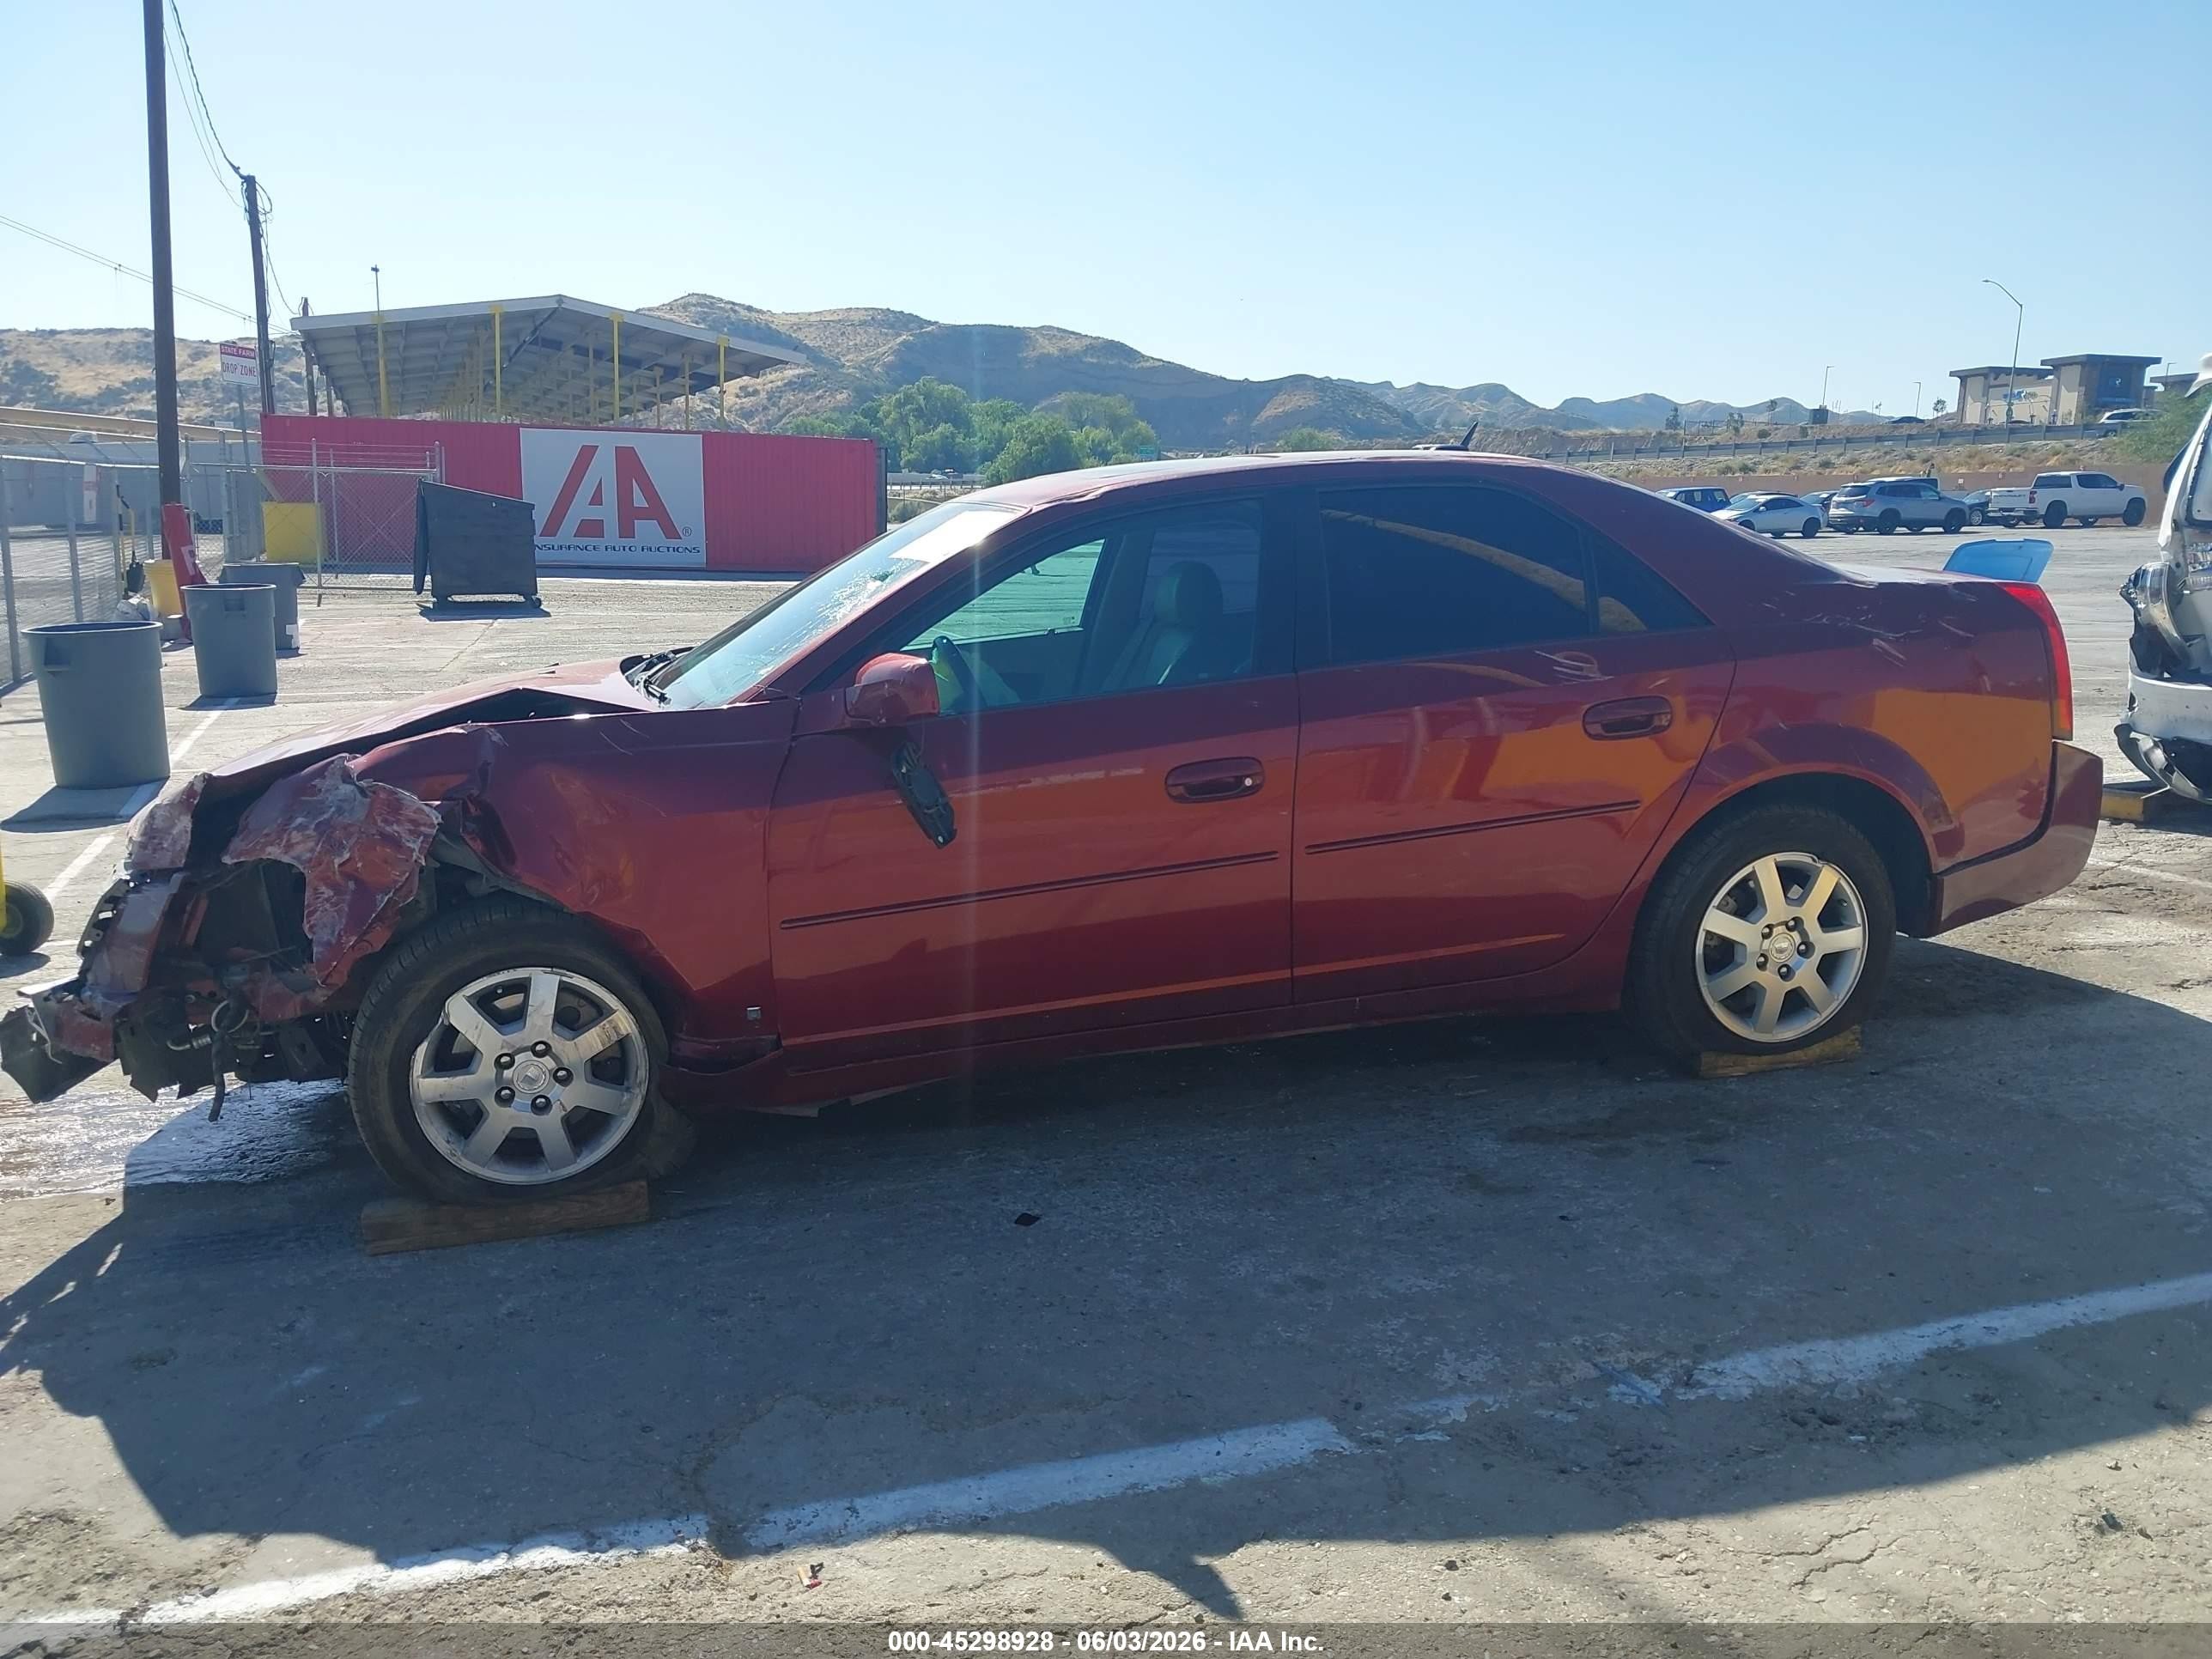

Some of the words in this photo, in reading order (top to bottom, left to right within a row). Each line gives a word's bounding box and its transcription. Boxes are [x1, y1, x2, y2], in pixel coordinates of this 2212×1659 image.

[222, 346, 238, 355] STATE
[239, 349, 255, 357] FARM
[222, 362, 239, 374] DROP
[240, 364, 257, 377] ZONE
[535, 544, 601, 552] NSURANCE
[641, 545, 701, 554] AUCTIONS
